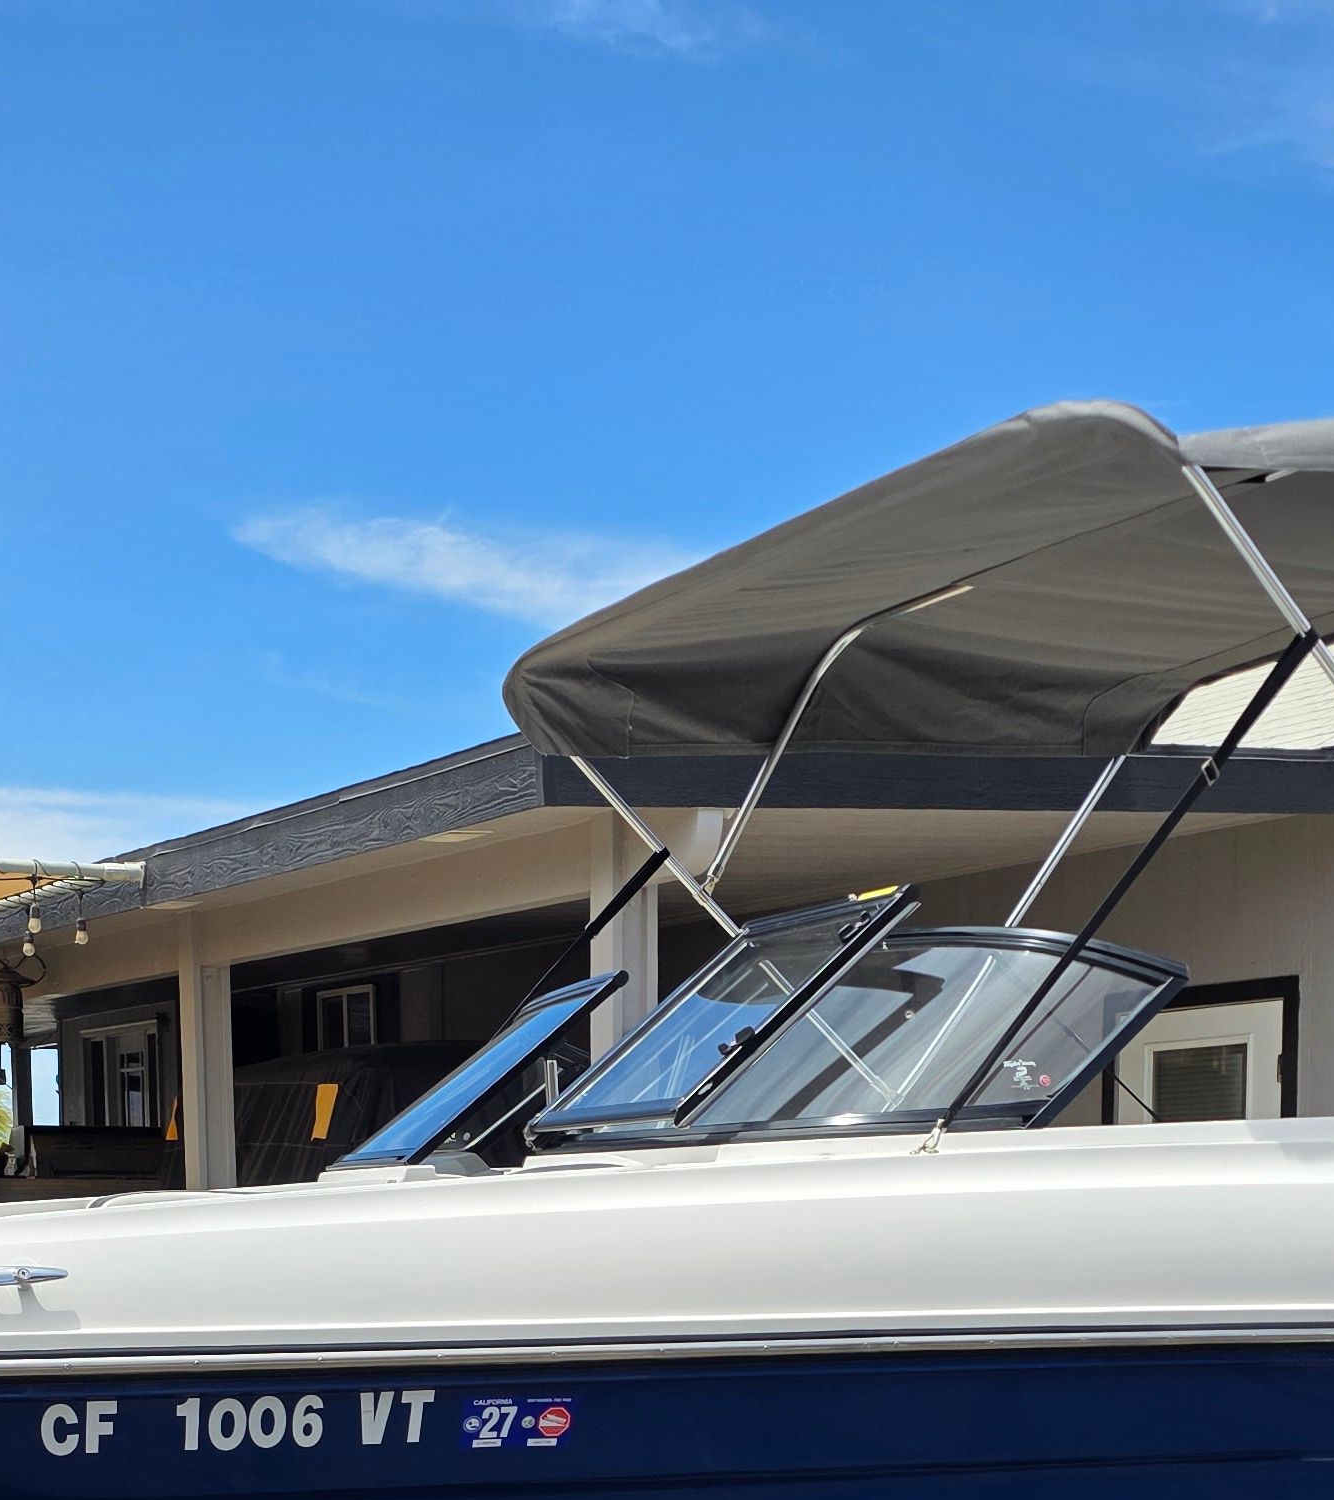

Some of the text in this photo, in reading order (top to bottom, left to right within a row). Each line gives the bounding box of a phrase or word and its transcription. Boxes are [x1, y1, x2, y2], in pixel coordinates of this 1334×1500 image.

[473, 1398, 513, 1406] CALIFORNIA
[40, 1389, 436, 1456] CF 1006 VT
[479, 1405, 518, 1438] 27
